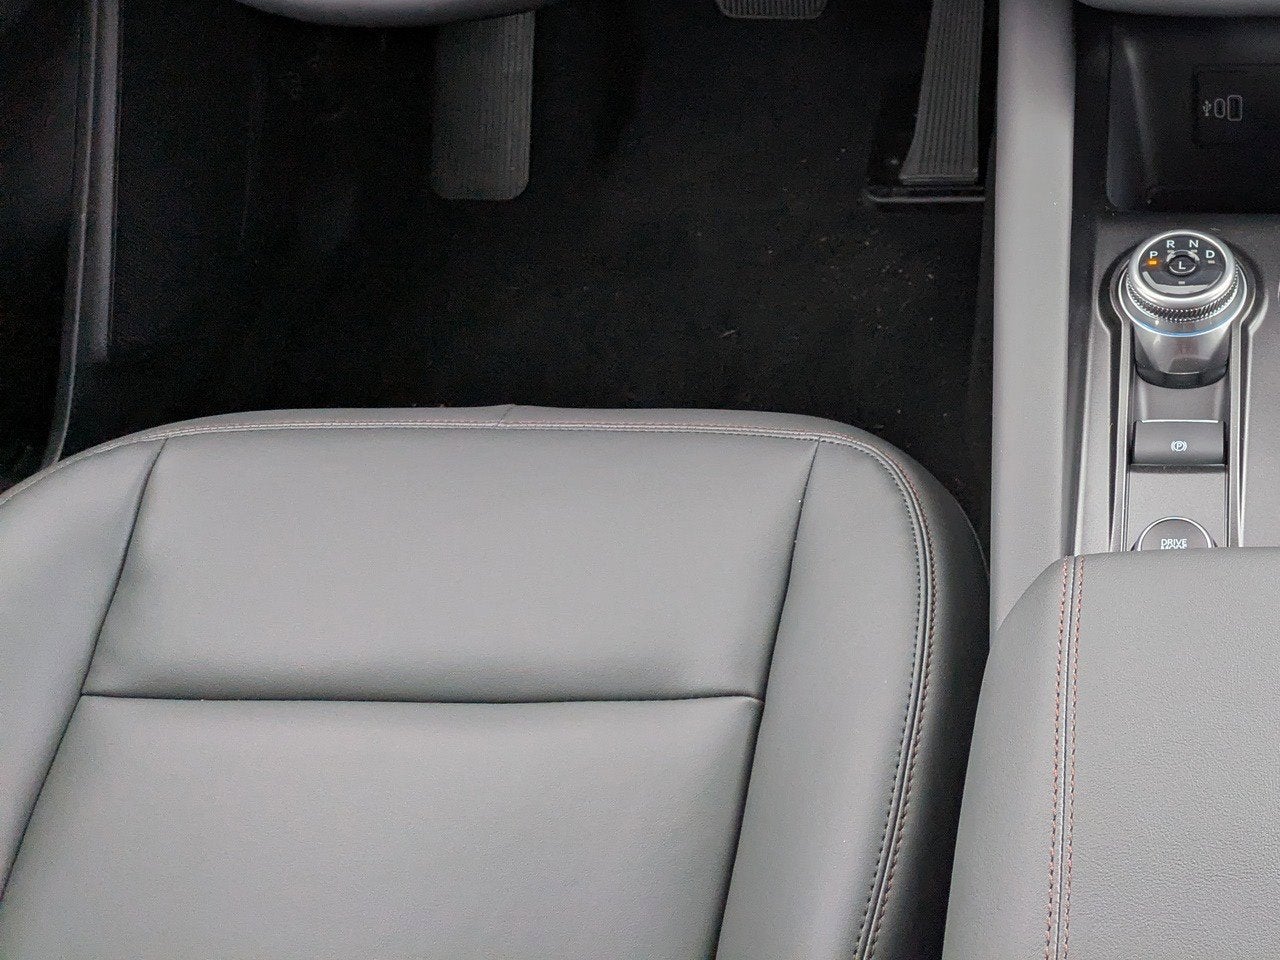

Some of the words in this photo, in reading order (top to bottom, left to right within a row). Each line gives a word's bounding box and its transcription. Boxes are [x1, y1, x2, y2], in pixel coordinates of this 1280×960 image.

[1149, 251, 1159, 259] P
[1166, 240, 1175, 248] R
[1189, 239, 1199, 248] N
[1205, 250, 1216, 258] D
[1178, 261, 1186, 270] L
[1160, 538, 1188, 546] DRIVE
